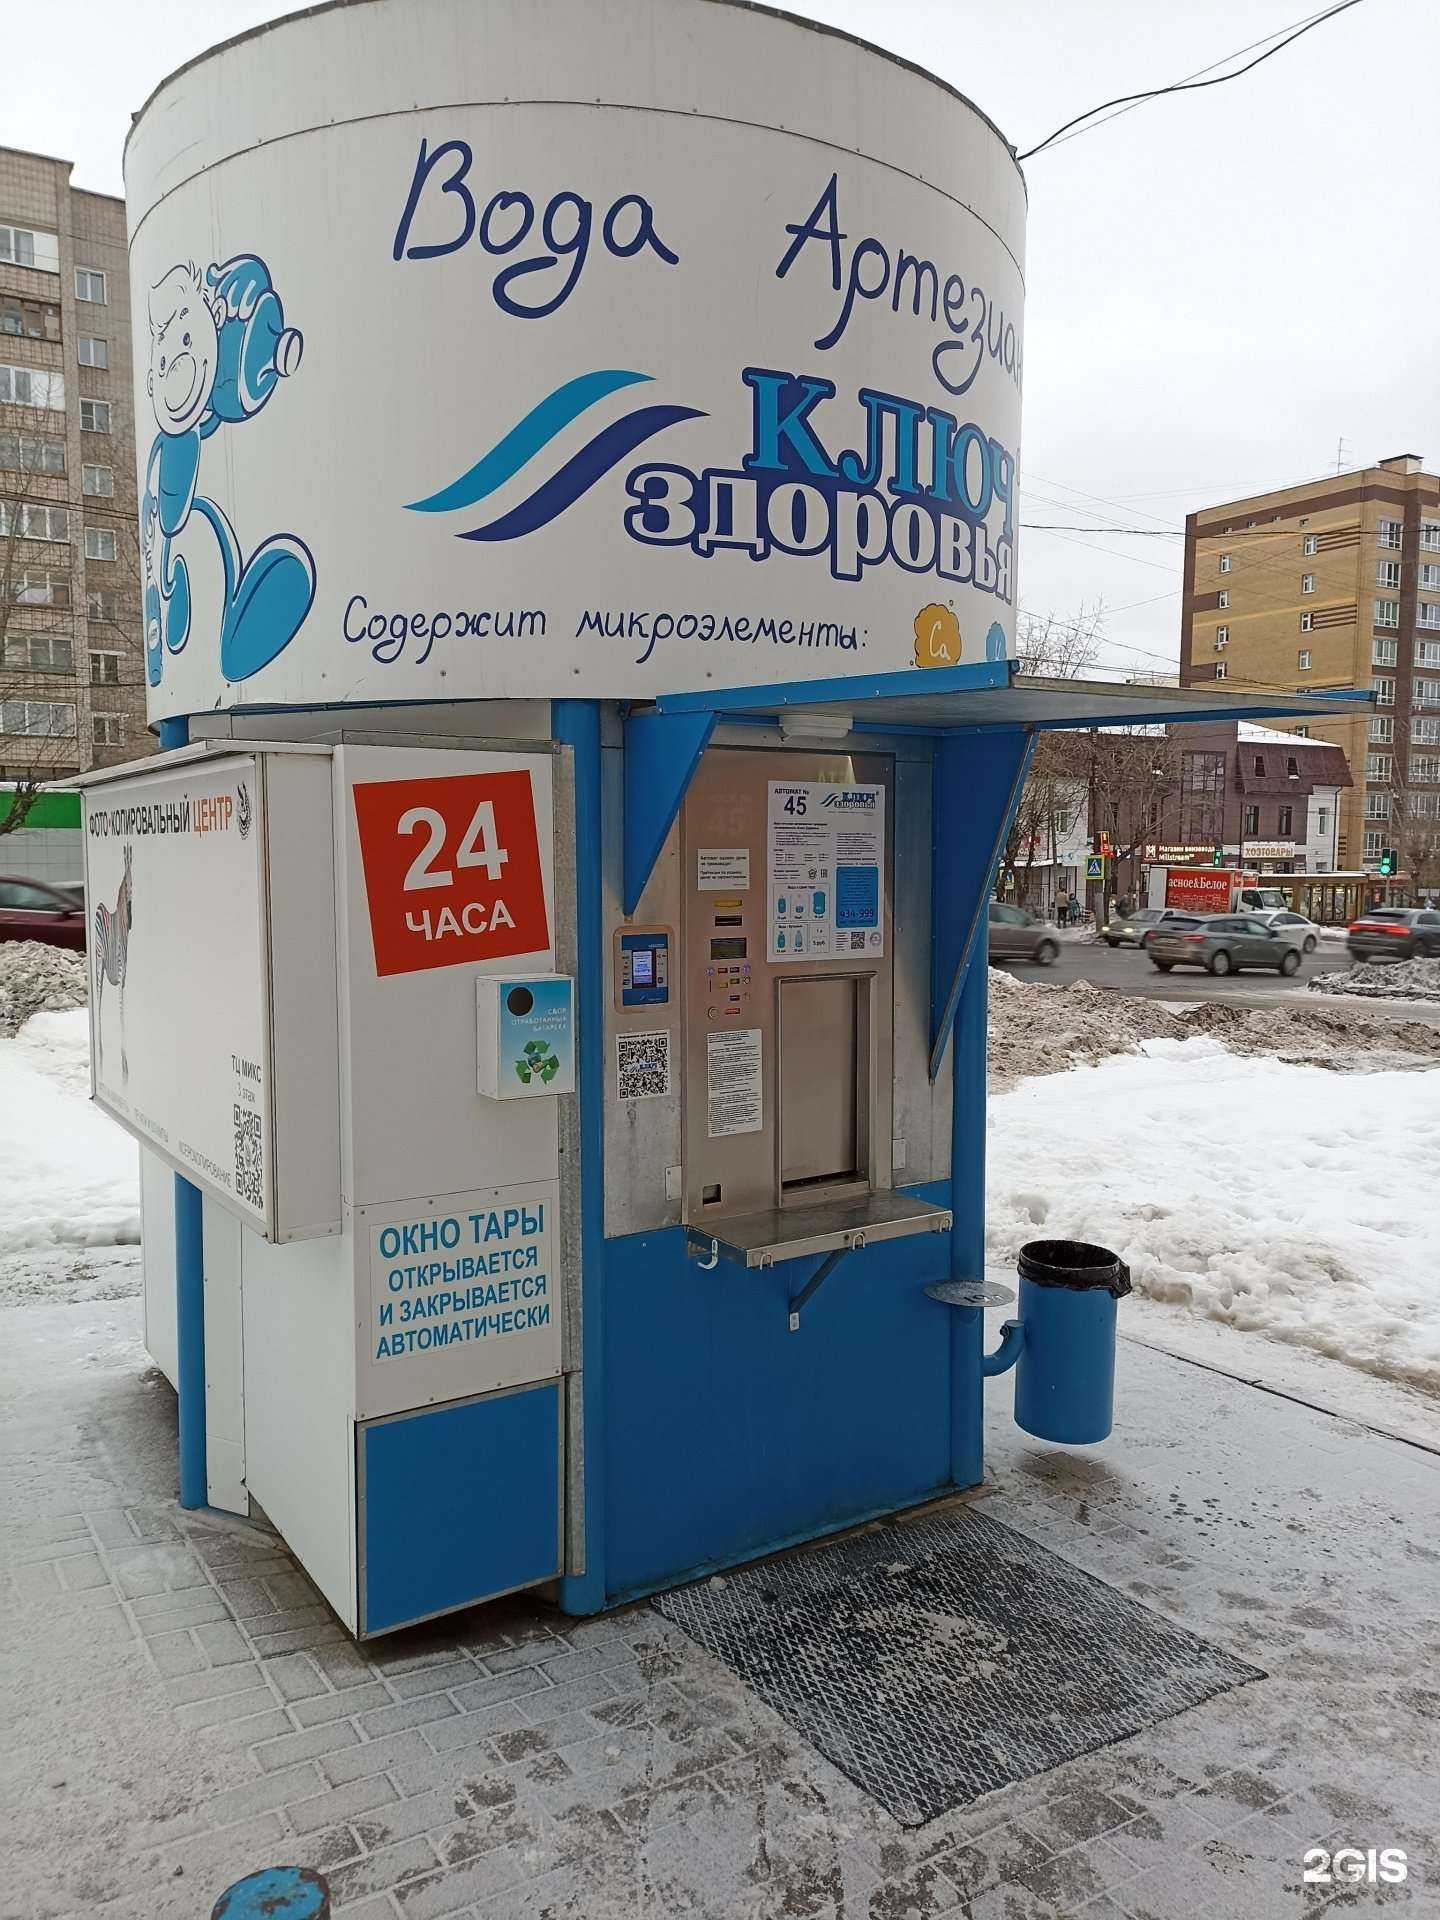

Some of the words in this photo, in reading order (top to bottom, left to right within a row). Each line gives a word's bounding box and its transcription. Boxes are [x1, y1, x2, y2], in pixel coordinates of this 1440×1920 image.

[392, 138, 680, 320] Вода
[743, 366, 1015, 541] КЛЮЧ
[343, 595, 547, 665] Содержит
[575, 610, 868, 664] микроэлементы:
[192, 795, 233, 838] ЦЕНТР
[783, 795, 807, 815] 45
[397, 800, 509, 891] 24
[1245, 847, 1293, 857] ХОЗТОВАРЫ
[405, 899, 517, 941] ЧАСА
[242, 1058, 262, 1084] МИКС
[379, 1218, 461, 1259] ОКНО
[468, 1204, 544, 1244] ТАРЫ
[388, 1246, 538, 1292] ОТКРЫВАЕТСЯ
[380, 1303, 393, 1327] И
[399, 1275, 547, 1322] ЗАКРЫВАЕТСЯ
[375, 1303, 551, 1360] АВТОМАТИЧЕСКИ
